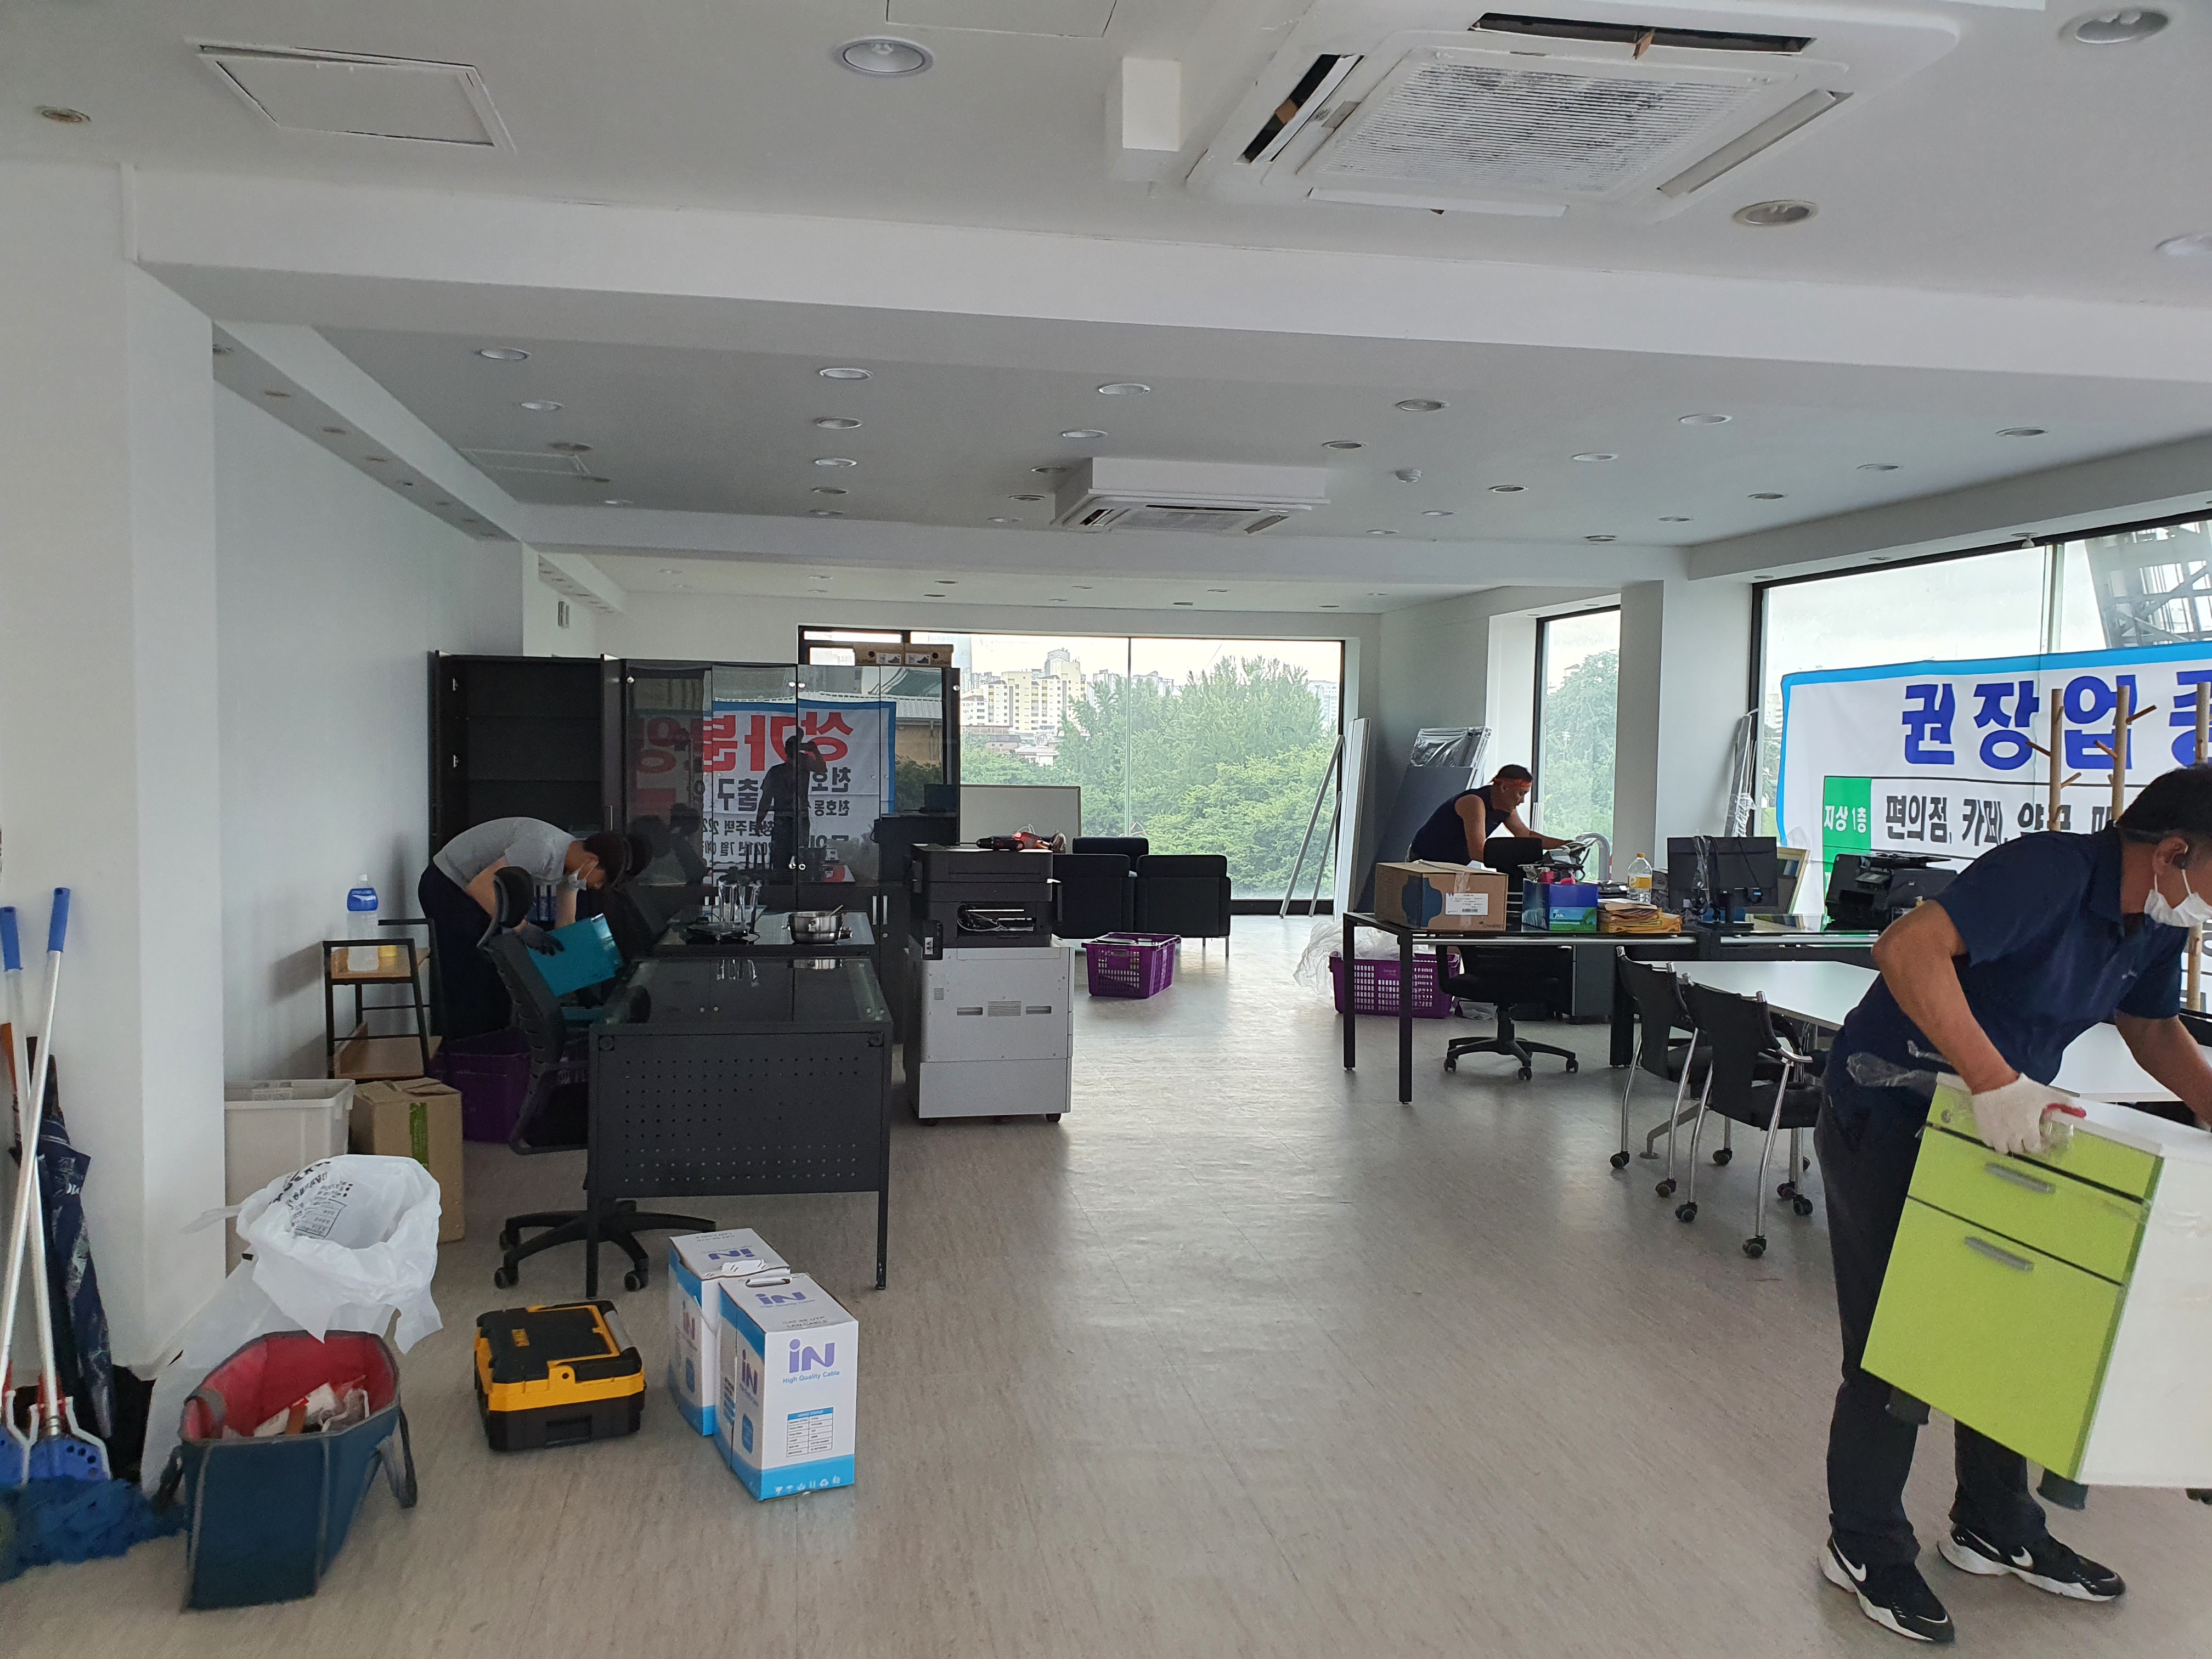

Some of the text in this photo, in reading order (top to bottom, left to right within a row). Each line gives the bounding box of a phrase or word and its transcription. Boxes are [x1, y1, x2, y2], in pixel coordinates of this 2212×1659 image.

[1824, 805, 1867, 833] 지상 1층
[1886, 795, 1951, 845] 편의점,
[789, 1339, 835, 1373] iN
[783, 1375, 798, 1384] High
[799, 1373, 821, 1381] Quality
